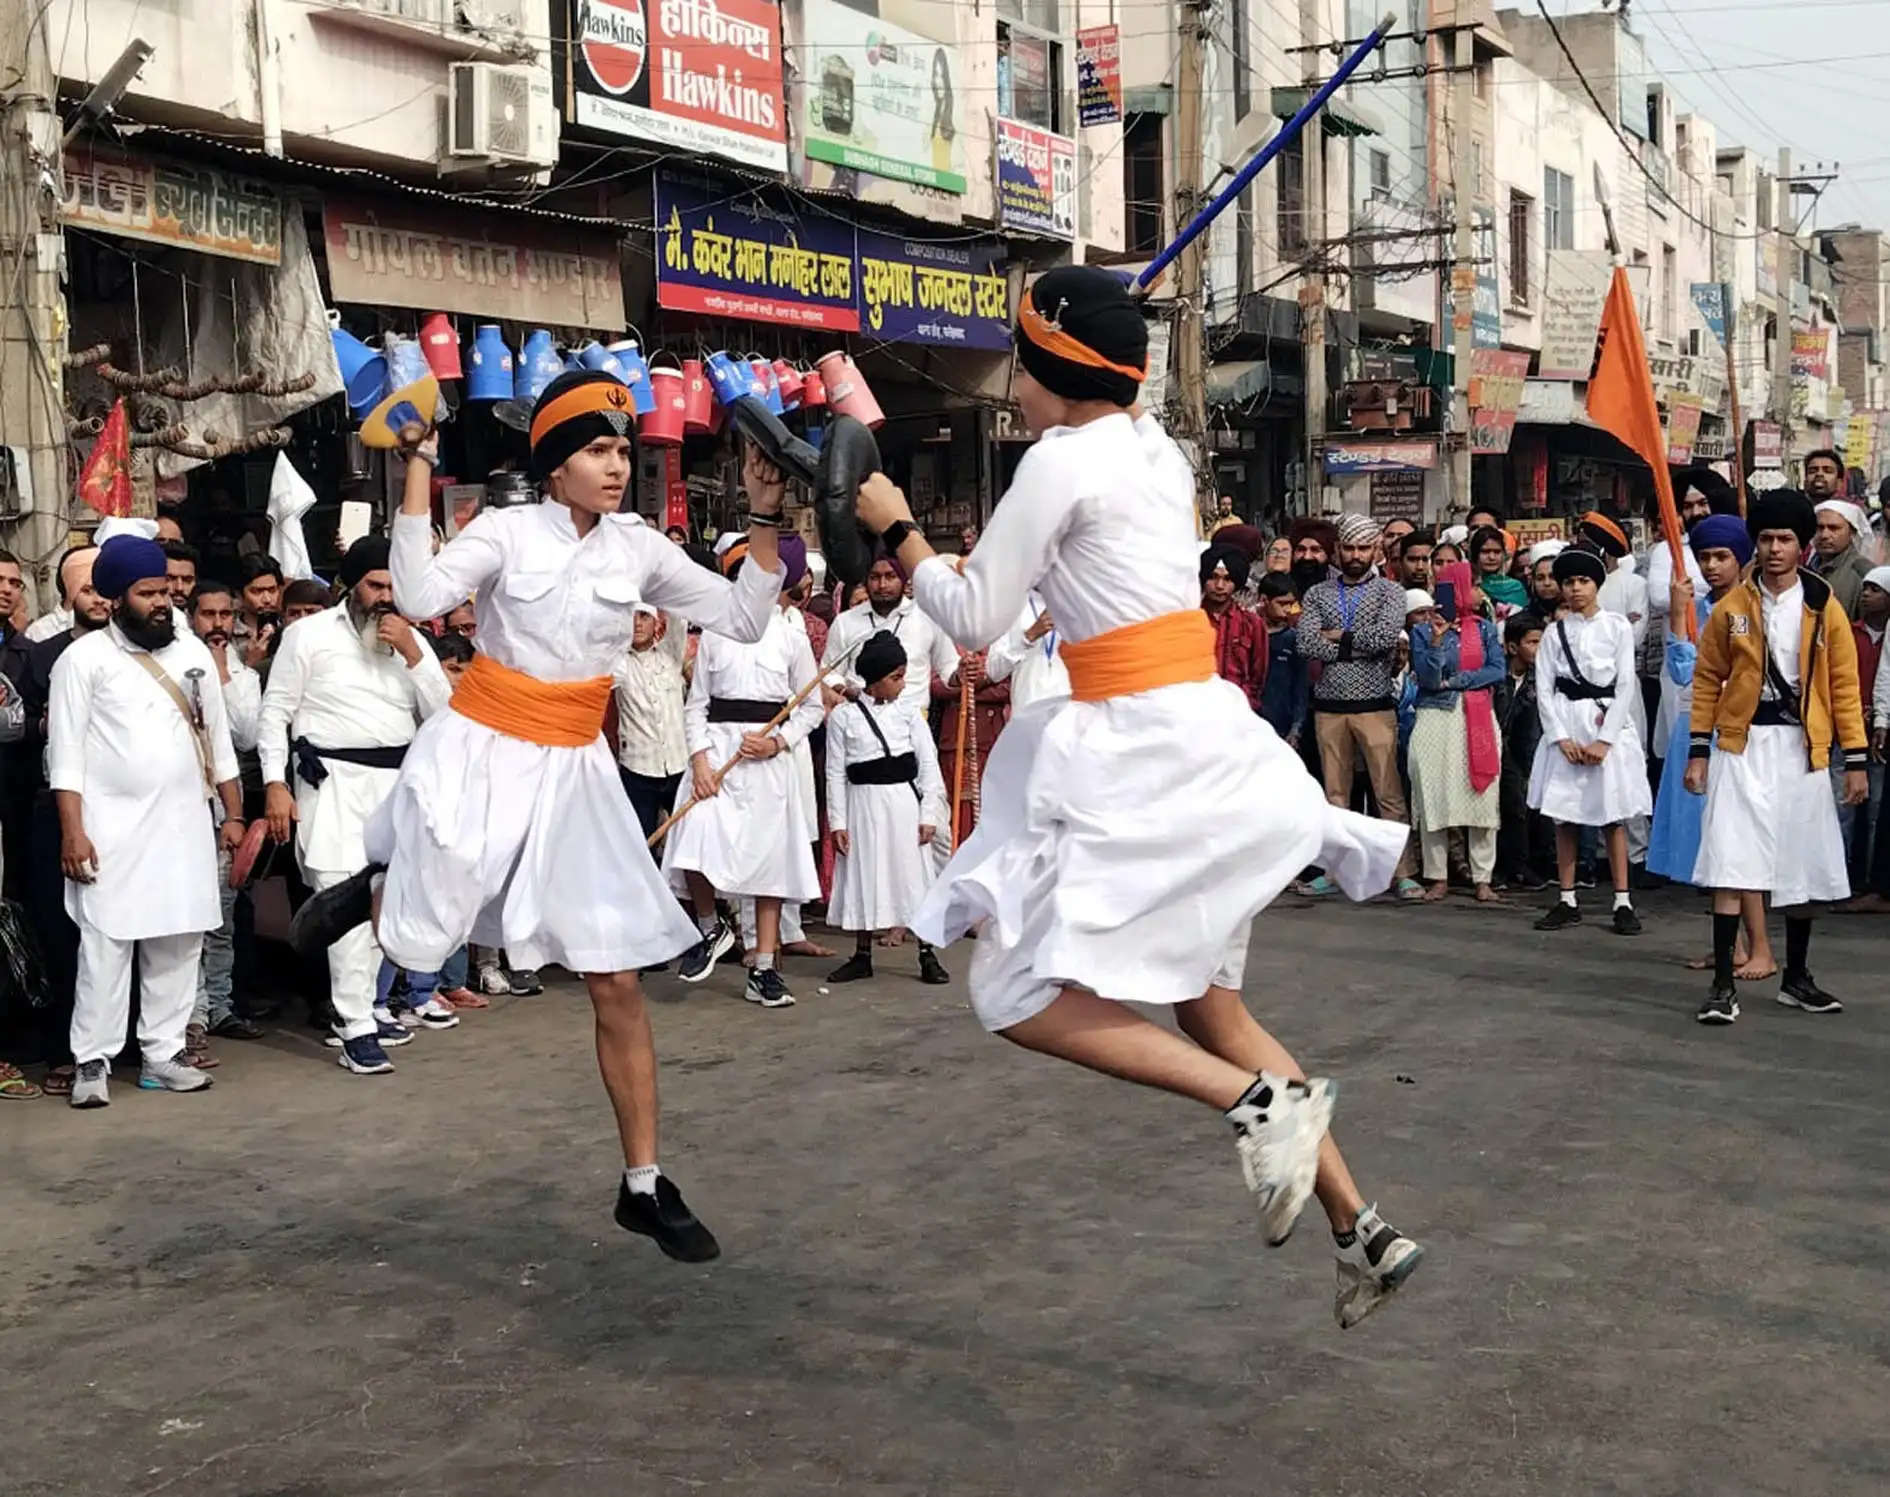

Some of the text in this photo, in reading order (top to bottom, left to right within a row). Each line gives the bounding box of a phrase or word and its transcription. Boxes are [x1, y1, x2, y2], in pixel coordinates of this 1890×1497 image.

[580, 3, 643, 47] Hawkins
[661, 48, 776, 129] Hawkins
[735, 238, 768, 286] भान
[769, 230, 819, 297] मनोहर
[820, 253, 851, 299] लाल
[862, 257, 914, 331] सुभाष
[915, 265, 972, 317] जनरल
[974, 259, 1008, 320] स्टोर
